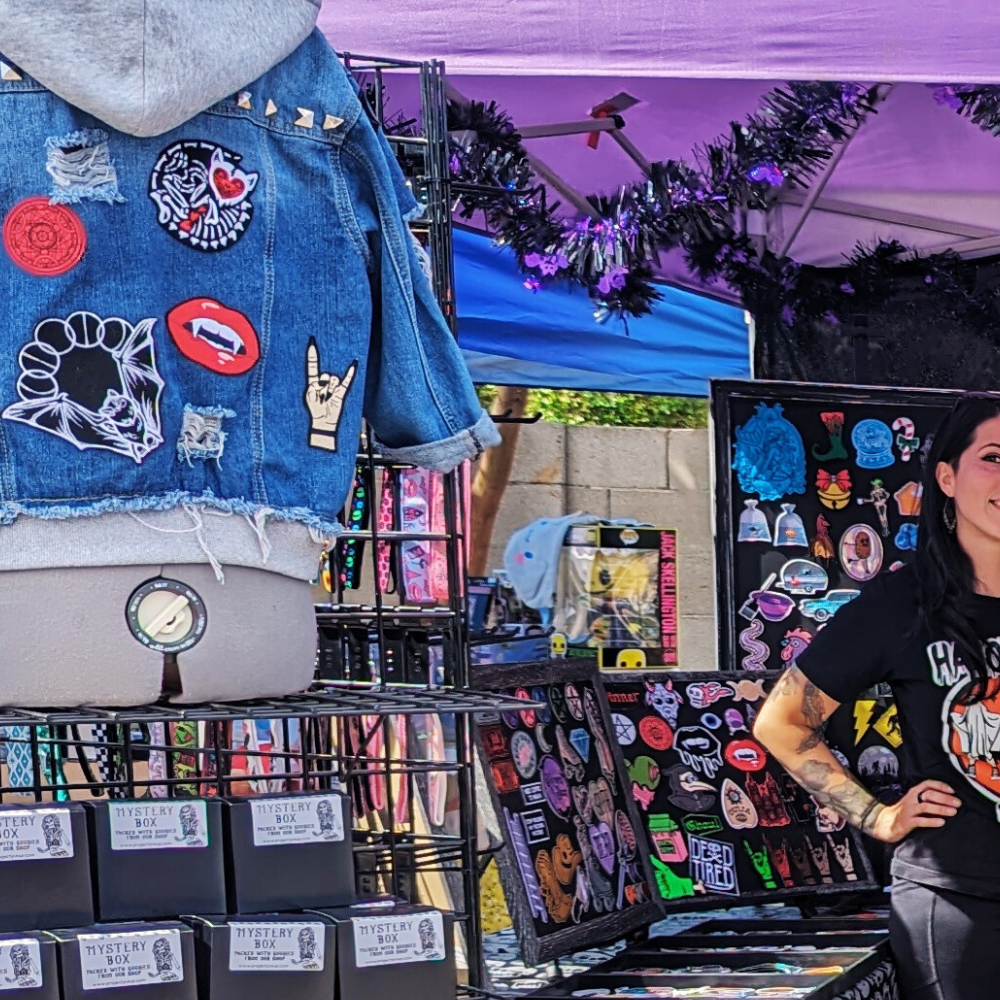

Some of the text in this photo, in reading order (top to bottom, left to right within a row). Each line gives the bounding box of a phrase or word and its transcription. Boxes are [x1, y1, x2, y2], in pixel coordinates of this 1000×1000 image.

[661, 531, 677, 559] JACK
[661, 562, 677, 634] SKELLINGTON
[116, 806, 174, 817] MYSTERY
[256, 802, 311, 814] MYSTERY
[0, 816, 36, 828] TERY
[134, 817, 158, 828] BOX
[275, 813, 297, 824] BOX
[0, 829, 19, 839] OX
[691, 859, 735, 890] TIRED
[235, 927, 294, 939] MYSTERY
[359, 921, 414, 935] MYSTERY
[254, 939, 277, 949] BOX
[377, 934, 399, 944] BOX
[85, 940, 147, 956] MYSTERY
[106, 954, 131, 965] BOX
